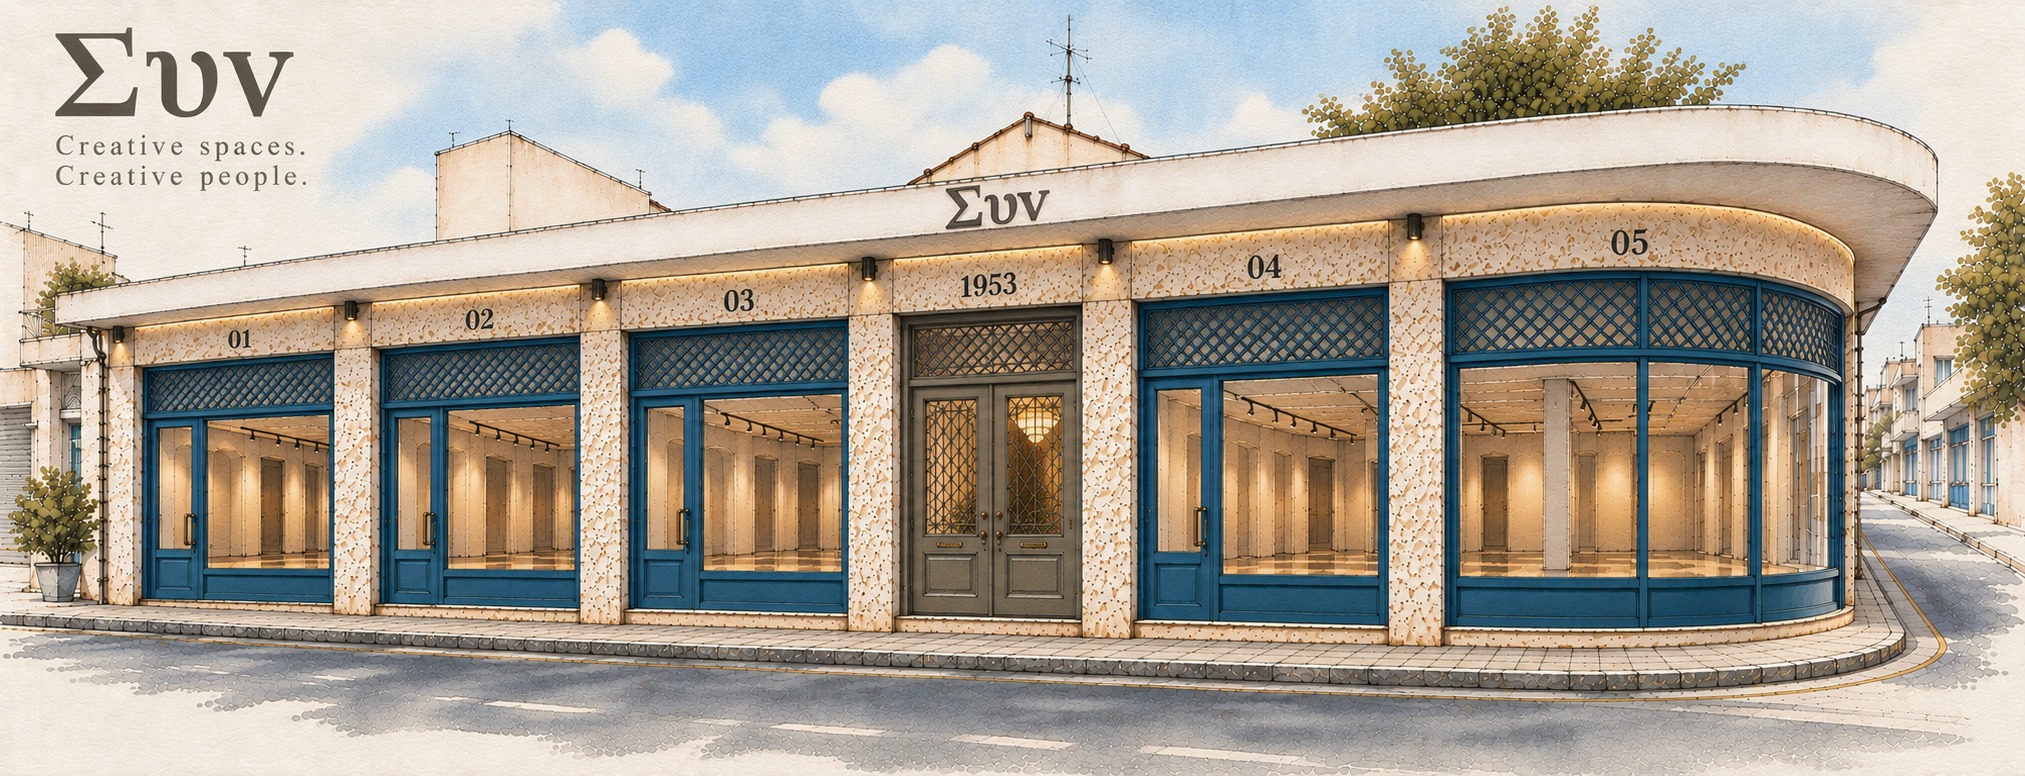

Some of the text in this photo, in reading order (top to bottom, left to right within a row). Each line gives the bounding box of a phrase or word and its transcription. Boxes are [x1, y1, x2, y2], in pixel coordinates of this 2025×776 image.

[945, 184, 1051, 230] Συν
[1611, 229, 1649, 256] 05
[1247, 254, 1282, 280] 04
[959, 272, 1017, 298] 1953
[723, 288, 756, 313] 03
[465, 308, 495, 331] 02
[227, 329, 251, 349] 01
